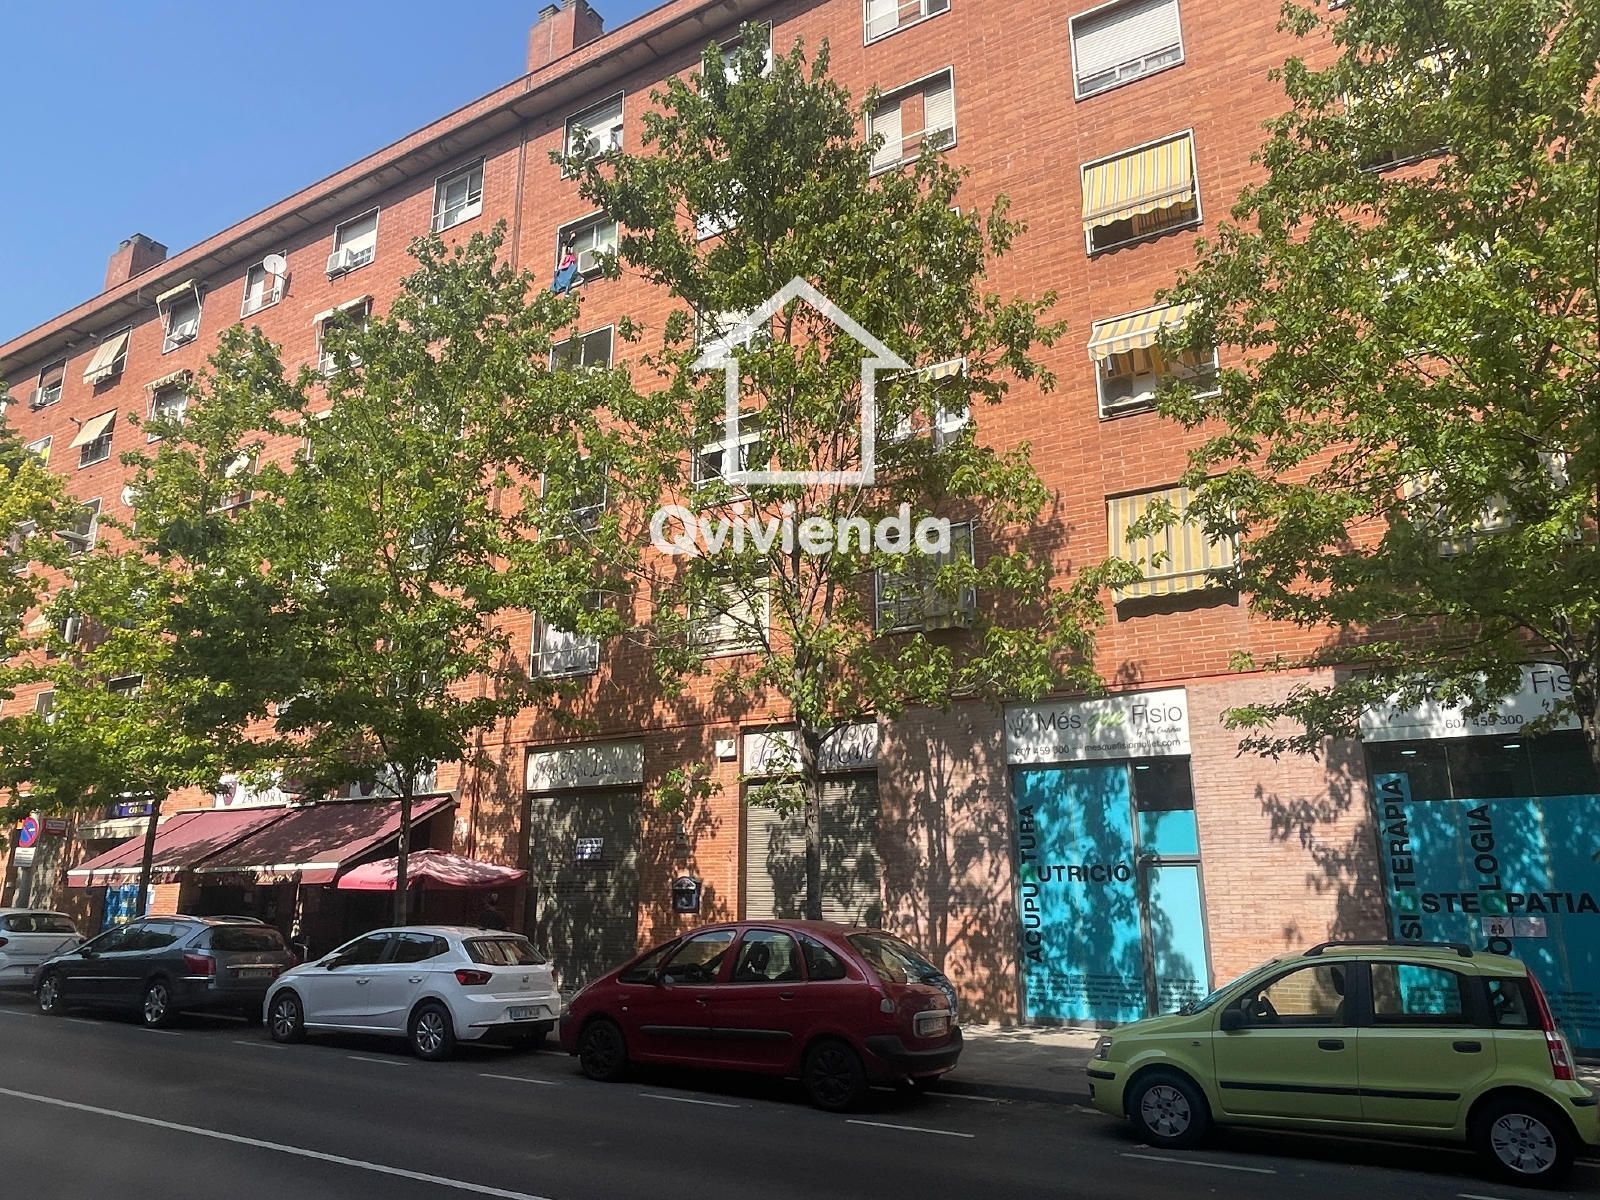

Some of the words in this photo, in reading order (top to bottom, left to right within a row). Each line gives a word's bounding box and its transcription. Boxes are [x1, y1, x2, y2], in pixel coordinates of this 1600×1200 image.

[1532, 671, 1573, 693] Fis
[1037, 710, 1082, 732] Més
[1132, 703, 1183, 724] Fisio
[1445, 719, 1466, 729] 607
[1472, 717, 1497, 727] 459
[1500, 715, 1524, 725] 300
